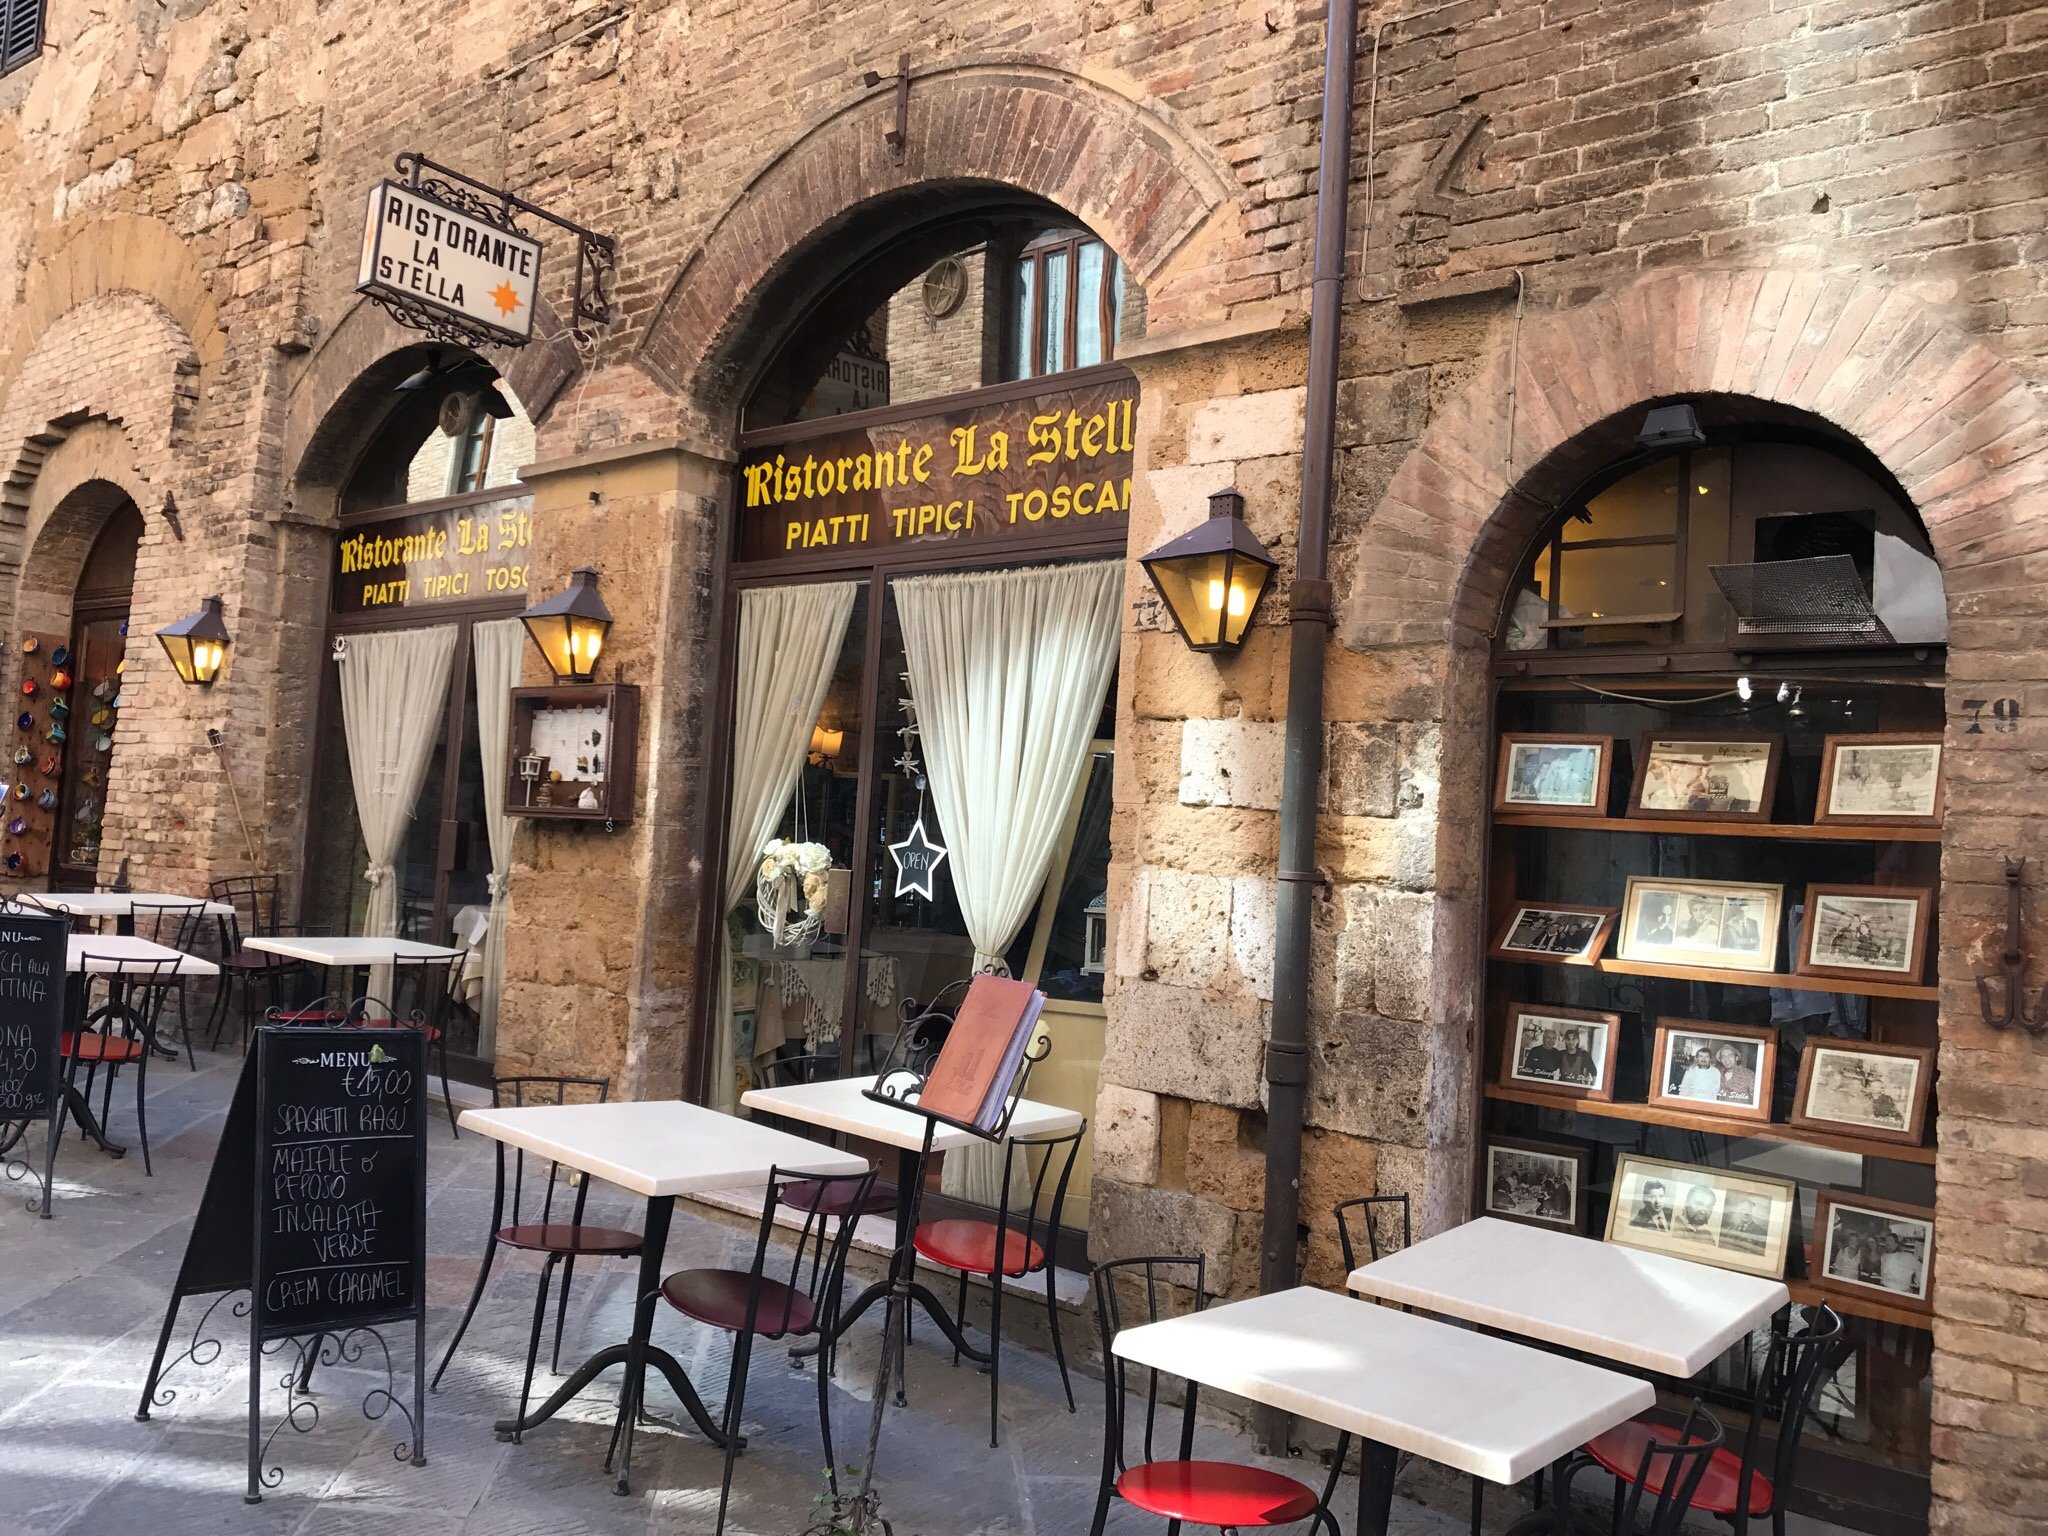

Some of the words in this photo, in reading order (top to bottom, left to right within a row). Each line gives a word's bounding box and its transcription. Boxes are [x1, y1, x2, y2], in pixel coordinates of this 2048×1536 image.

[387, 195, 532, 278] RISTORANTE
[413, 239, 439, 271] LA
[379, 255, 464, 307] STELLA
[743, 438, 935, 508] Ristorante
[949, 424, 1009, 478] La
[1026, 398, 1134, 467] Stell
[785, 513, 869, 550] PIATTI
[892, 499, 974, 538] TIPICI
[1006, 477, 1133, 525] TOSCAN
[340, 525, 447, 574] Ristorante
[457, 518, 489, 555] La
[362, 580, 411, 606] PIATTI
[423, 573, 469, 598] TIPICI
[486, 565, 529, 592] TOSC
[1961, 698, 2020, 734] 79
[903, 851, 930, 871] OPEN
[320, 1052, 371, 1068] MENU
[272, 1144, 353, 1175] MAIALE
[272, 1199, 383, 1234] INSALATA
[313, 1228, 379, 1263] VERDE
[266, 1276, 319, 1312] CREM
[328, 1270, 405, 1304] CARAMEL
